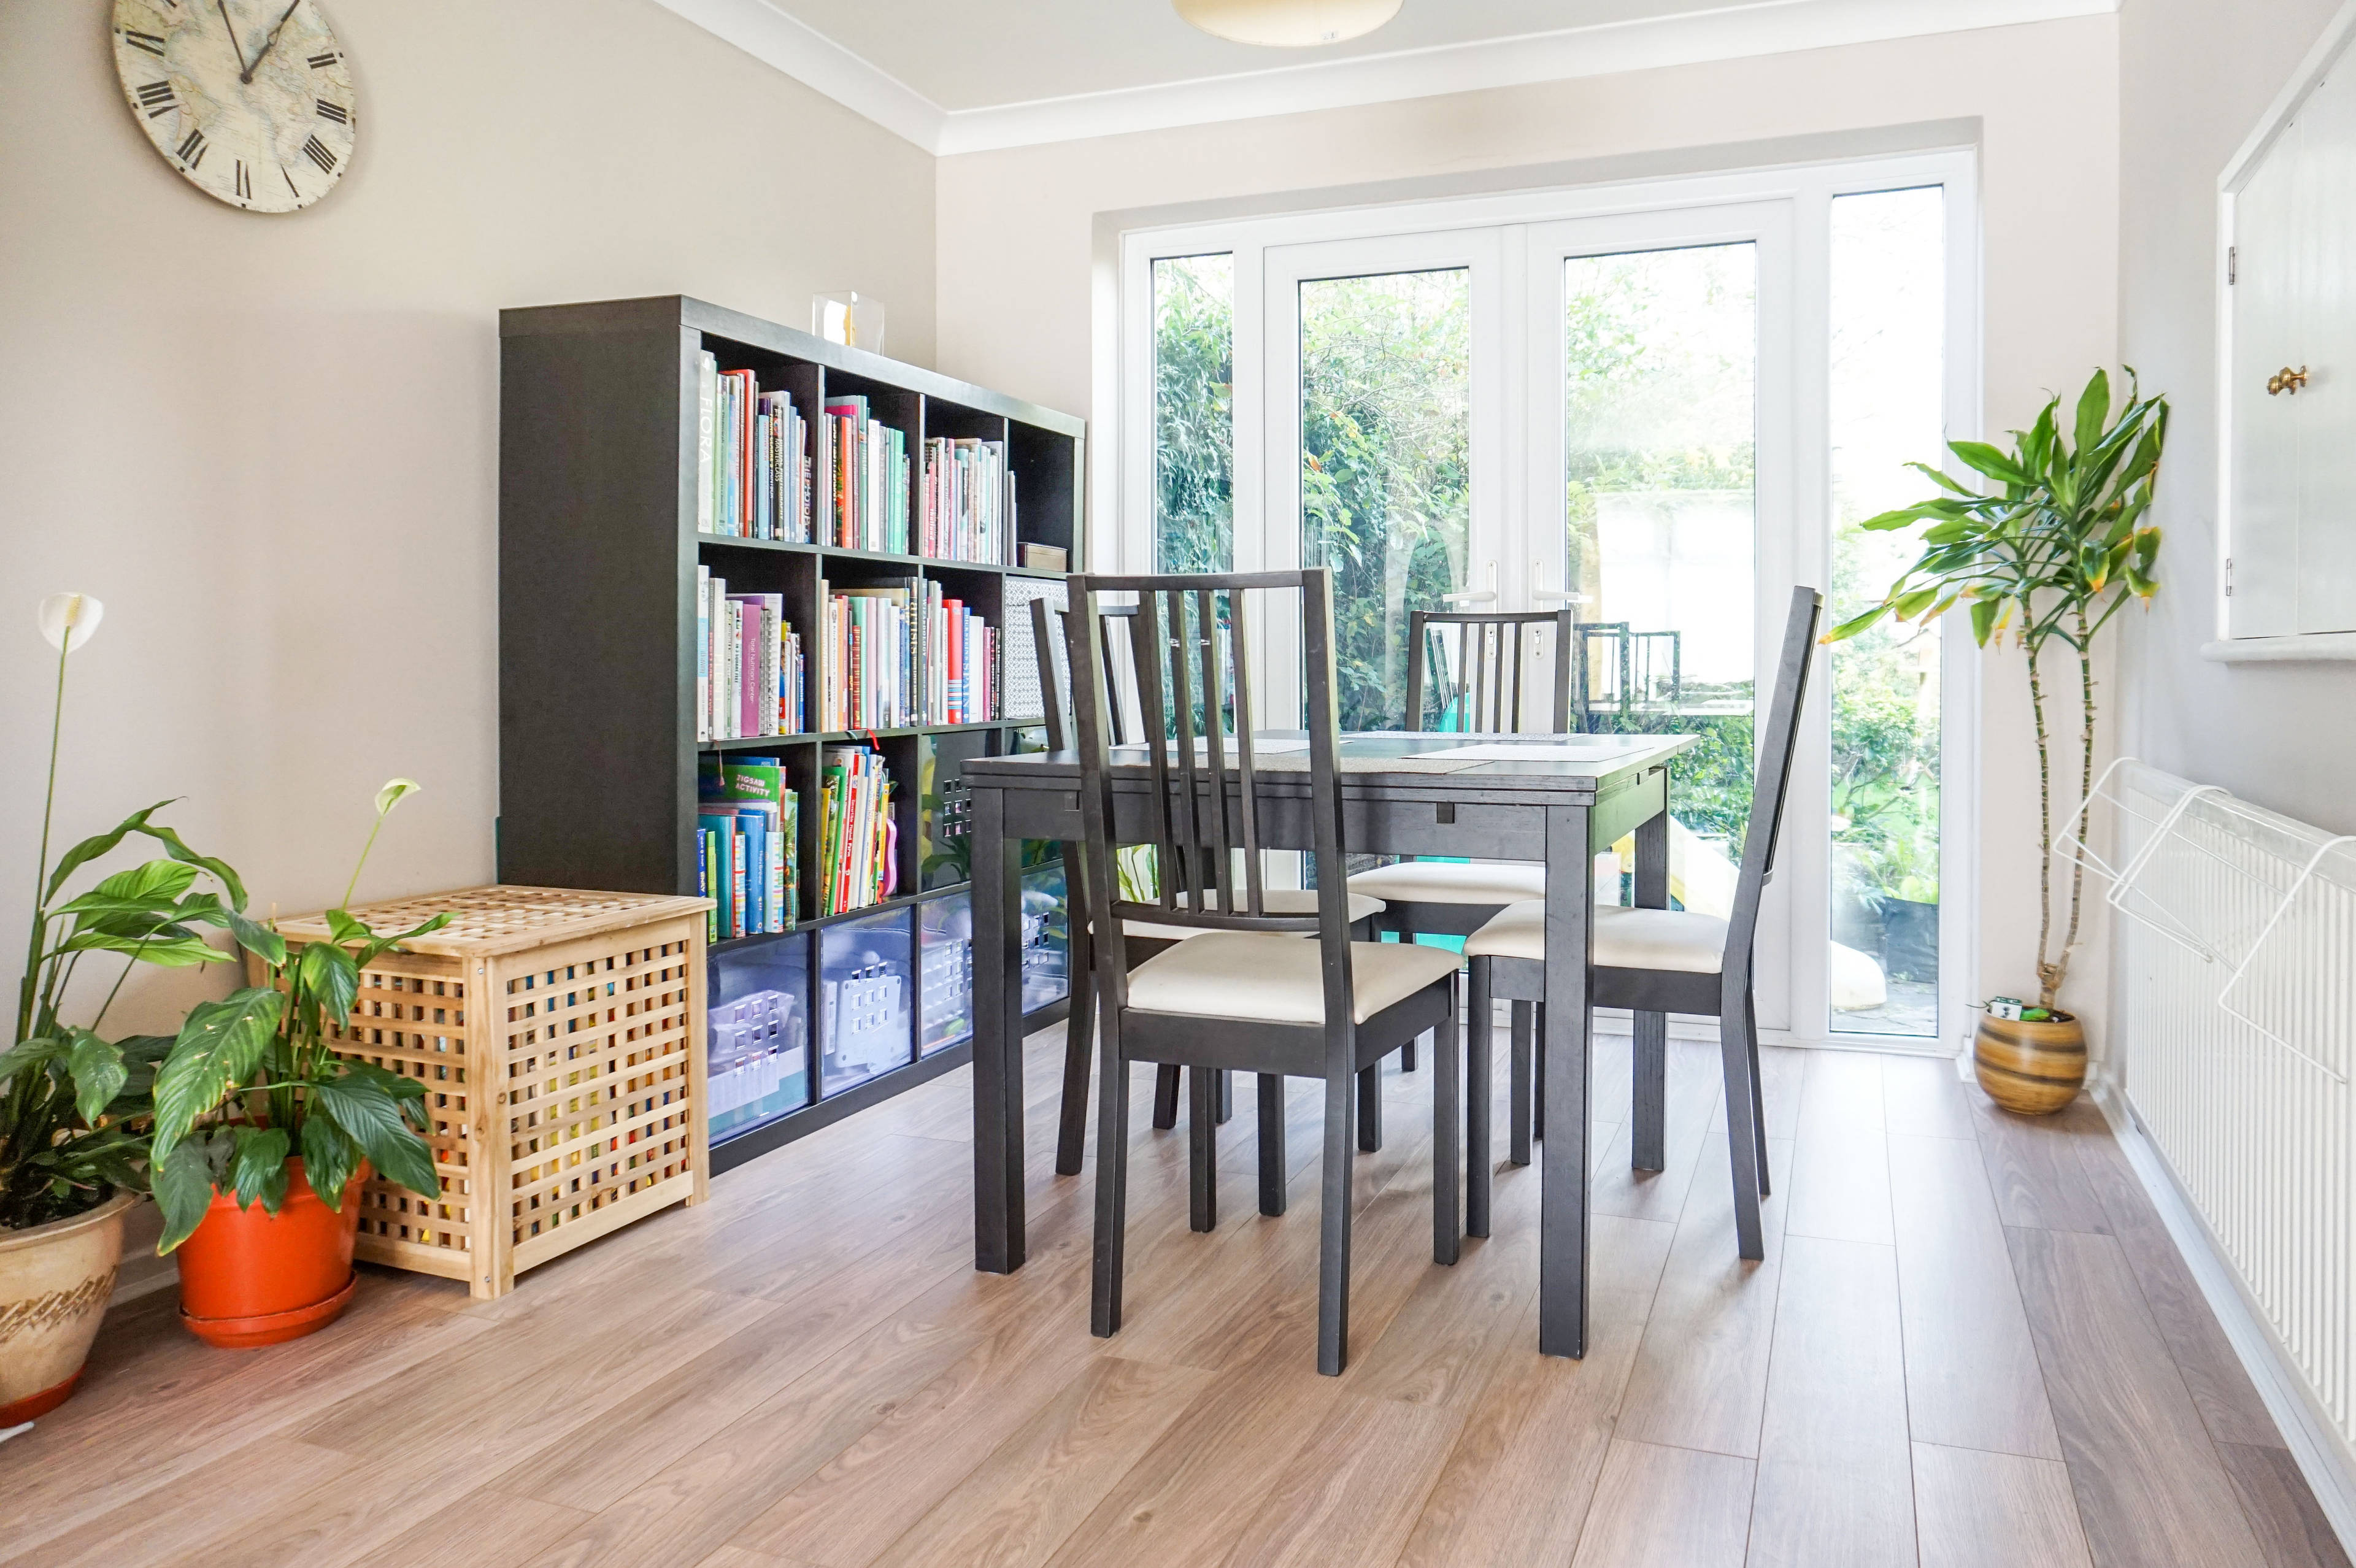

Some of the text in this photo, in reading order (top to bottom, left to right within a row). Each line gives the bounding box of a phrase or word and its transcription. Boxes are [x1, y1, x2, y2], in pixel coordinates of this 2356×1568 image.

[700, 396, 713, 463] FLORA
[736, 774, 766, 787] JIGSAW
[735, 783, 771, 797] ACTIVITY
